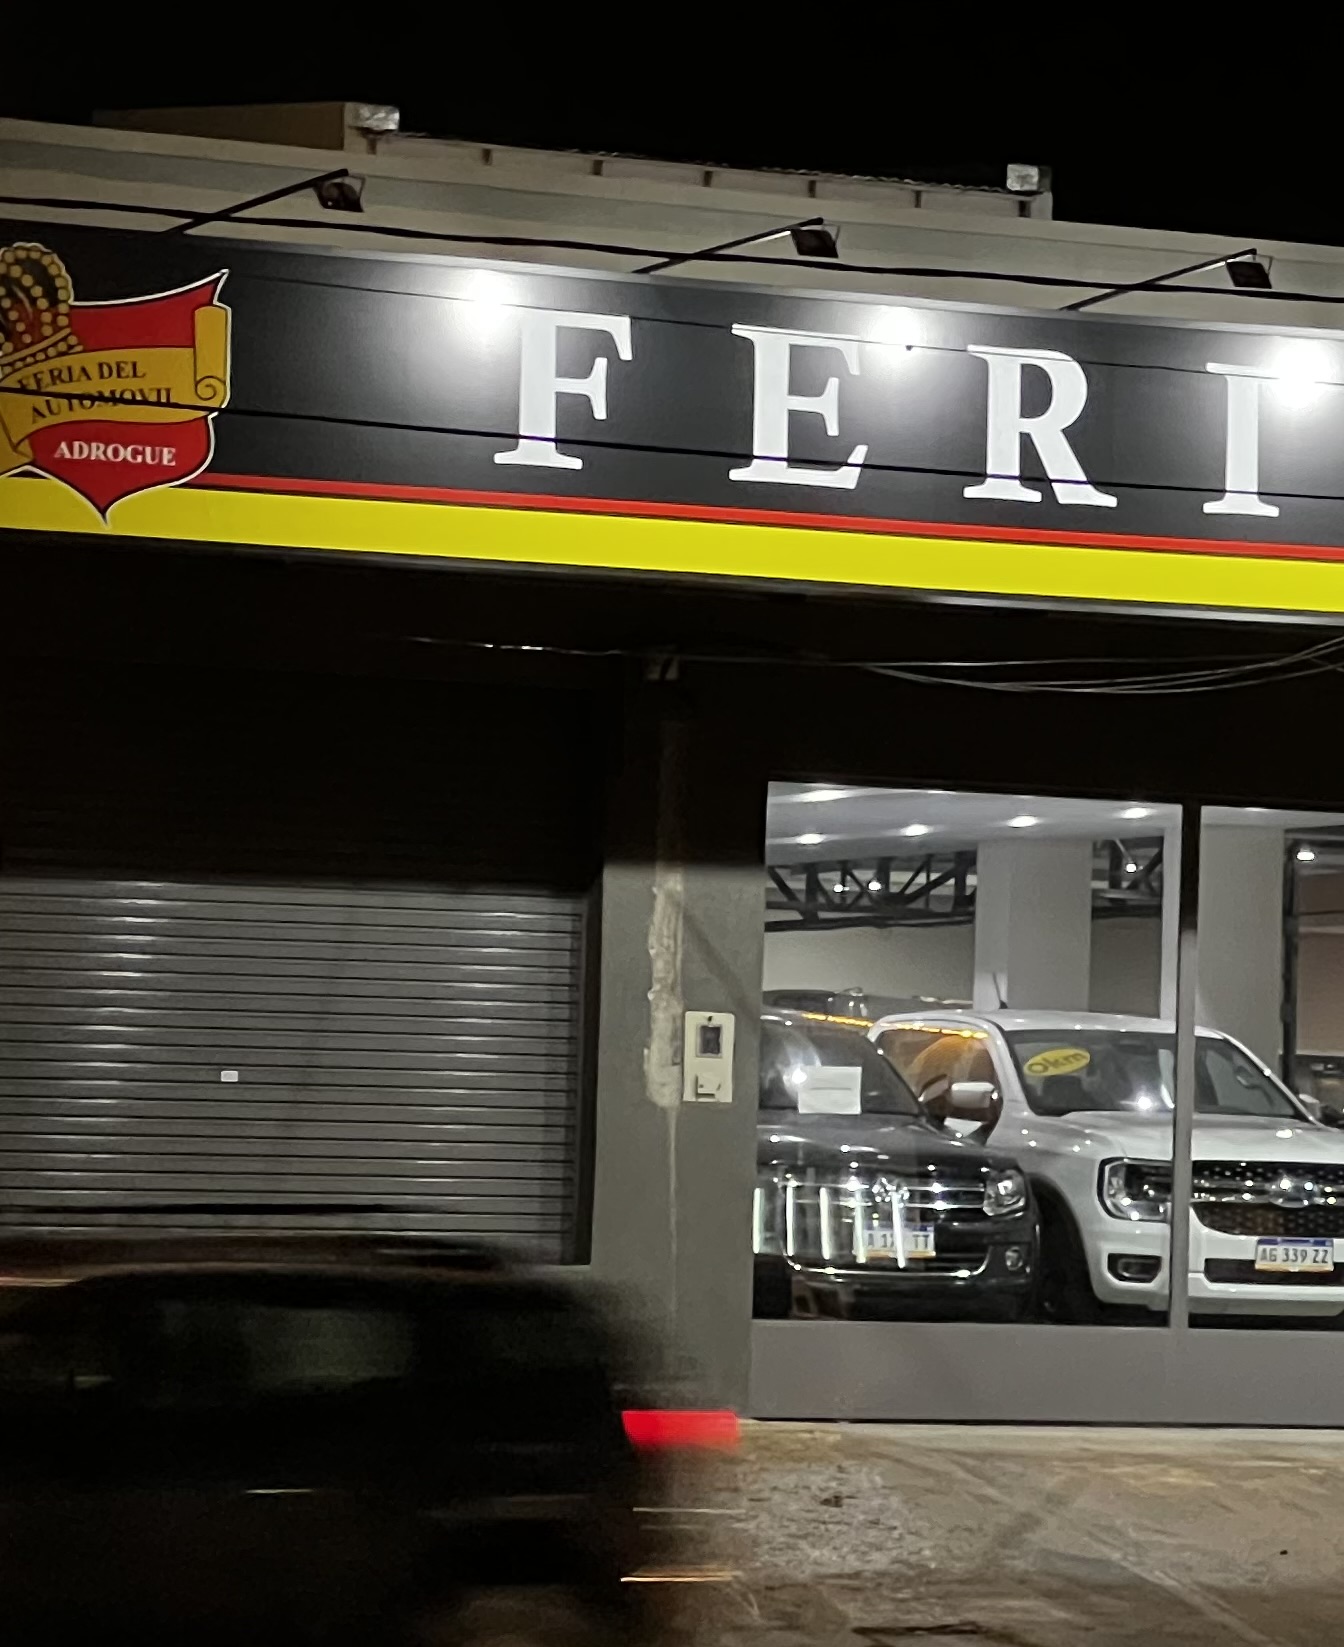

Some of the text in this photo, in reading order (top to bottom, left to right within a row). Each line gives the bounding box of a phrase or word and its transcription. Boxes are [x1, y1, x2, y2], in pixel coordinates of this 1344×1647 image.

[18, 360, 146, 390] FERIA DEL
[54, 440, 177, 467] ADROGUE
[1260, 1247, 1329, 1264] AG 339 ZZ
